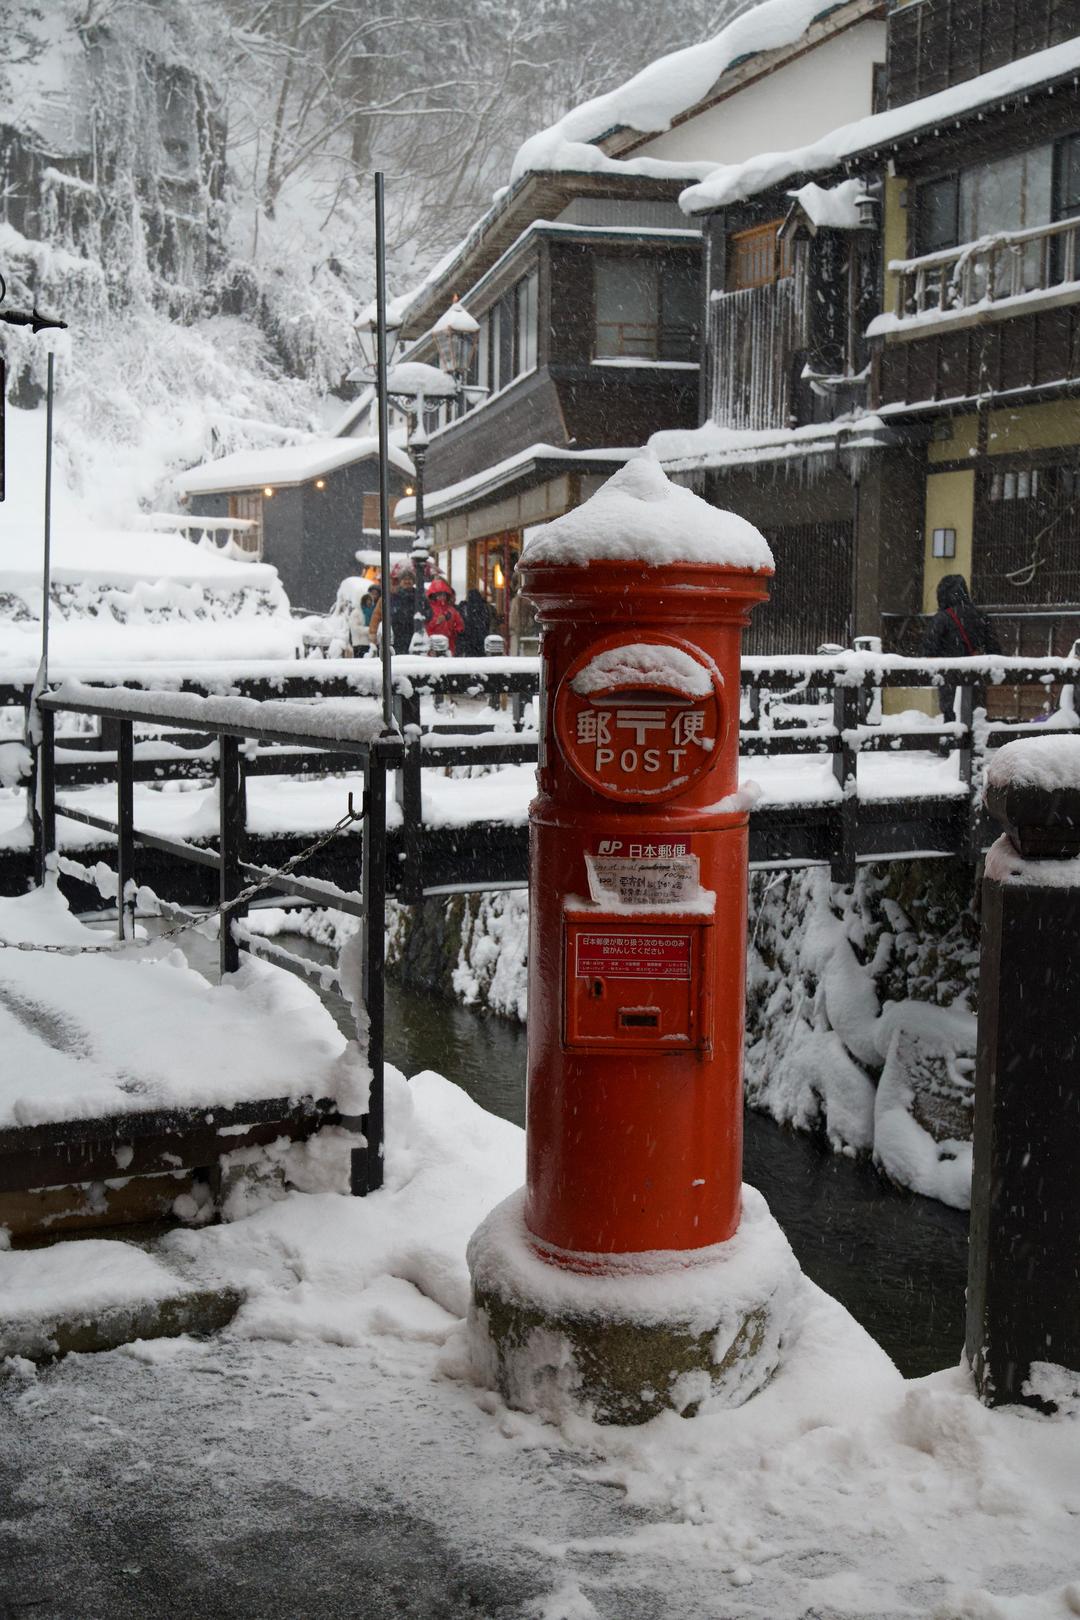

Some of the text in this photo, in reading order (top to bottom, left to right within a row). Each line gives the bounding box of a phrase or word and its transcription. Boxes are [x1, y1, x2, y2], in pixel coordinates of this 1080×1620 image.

[595, 748, 687, 773] POST
[598, 840, 687, 859] JP 日本郵便
[582, 936, 685, 948] 日本郵便が取り扱う次のもののみ
[602, 946, 665, 955] 投かんしてください
